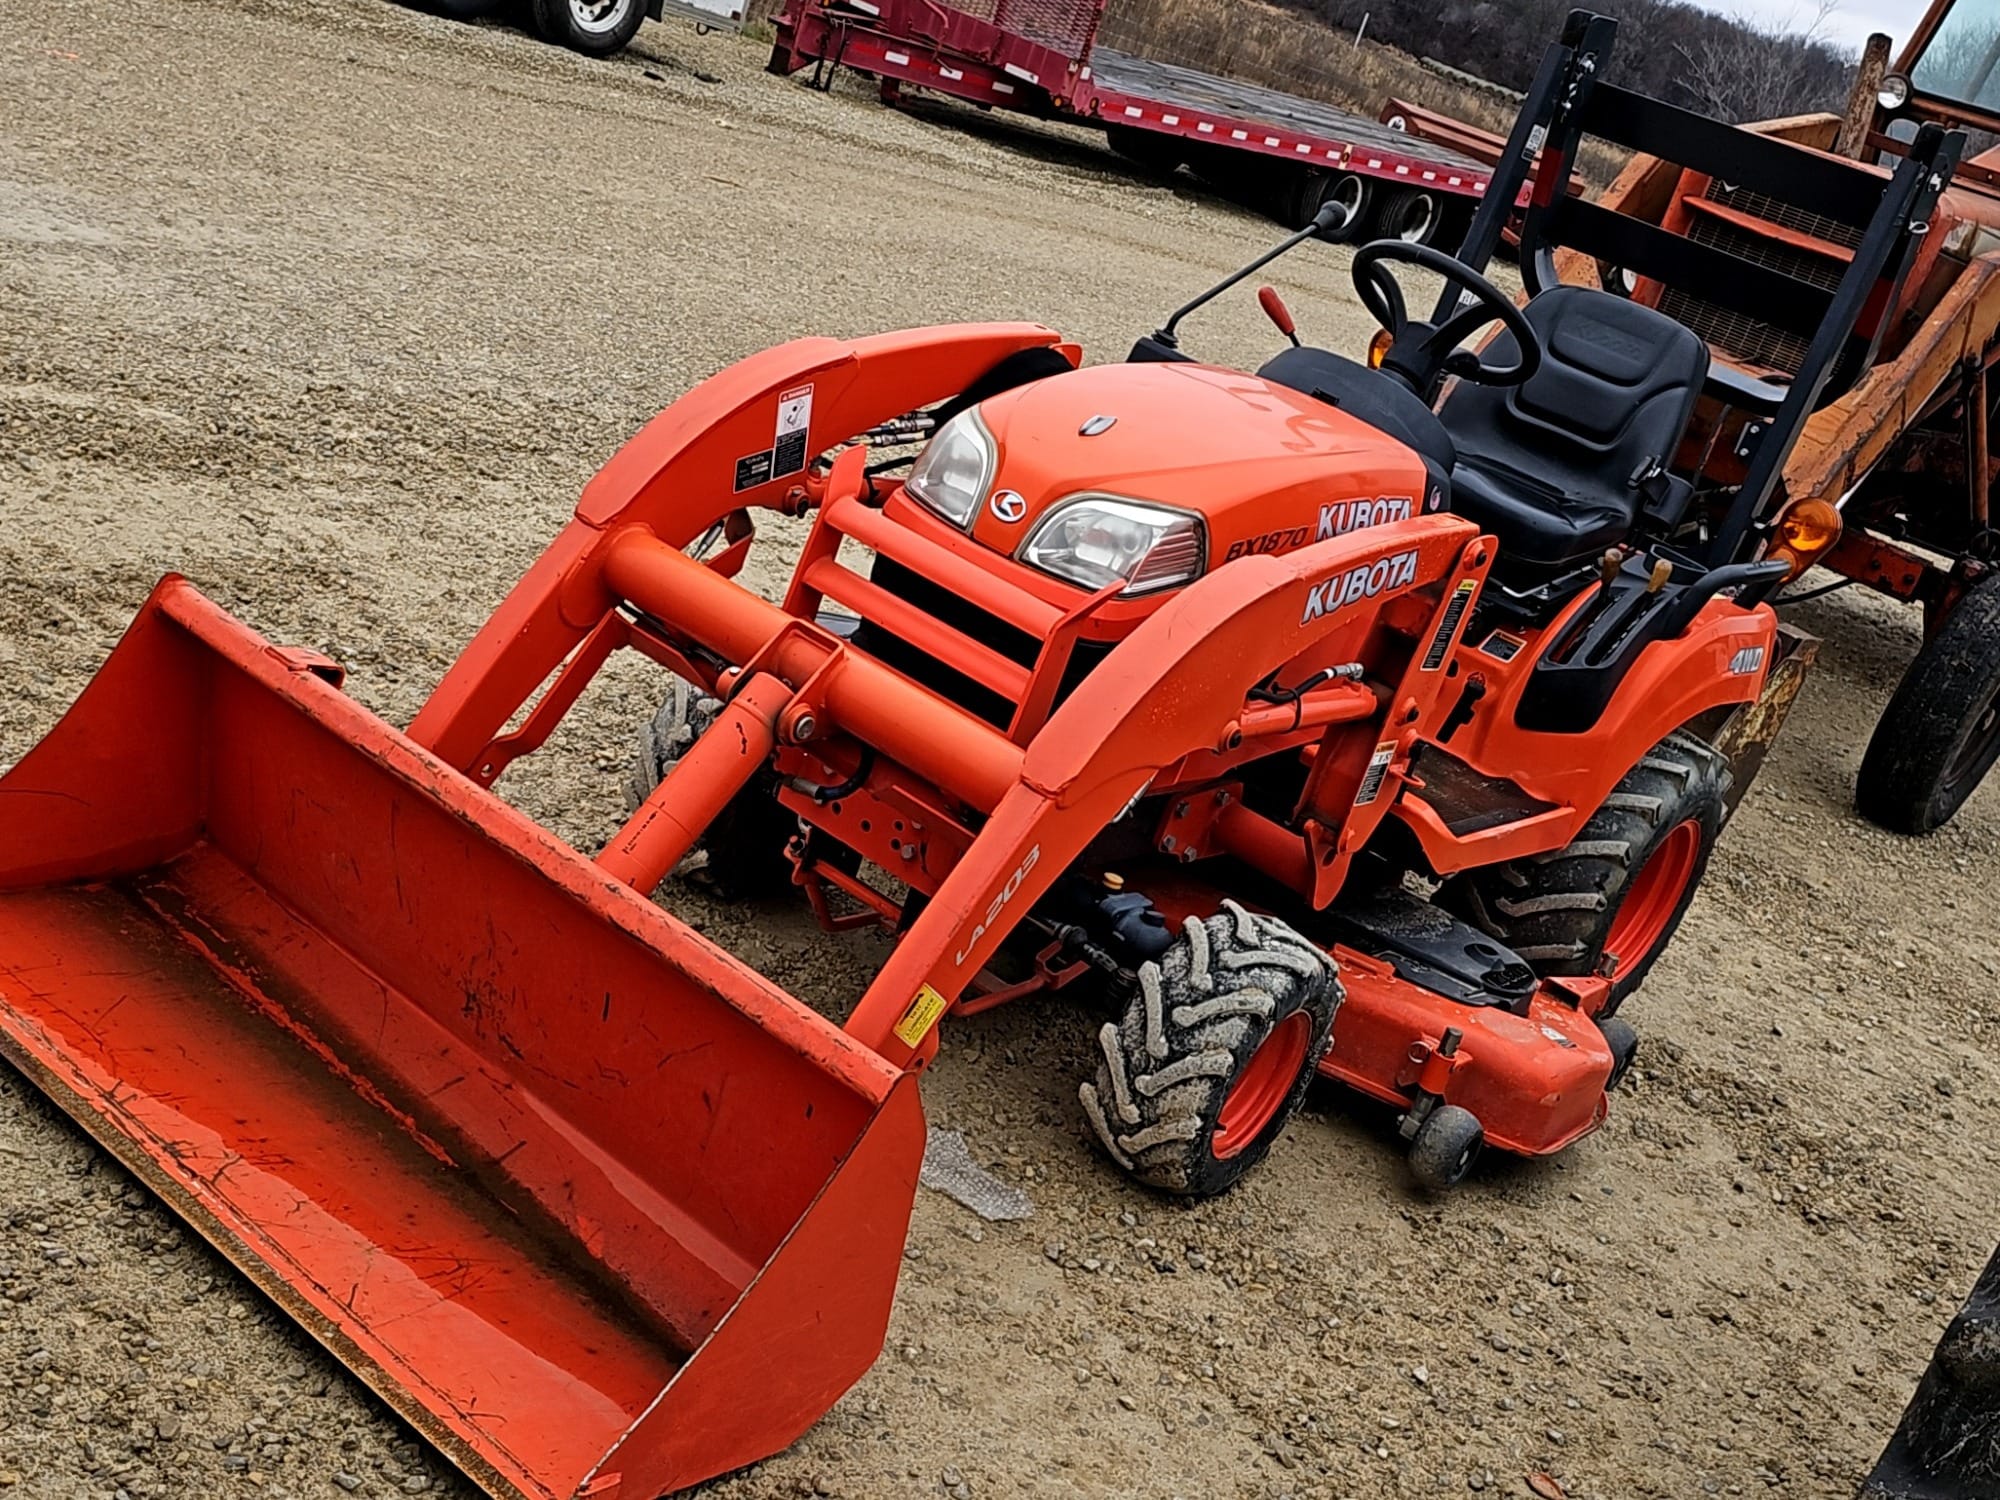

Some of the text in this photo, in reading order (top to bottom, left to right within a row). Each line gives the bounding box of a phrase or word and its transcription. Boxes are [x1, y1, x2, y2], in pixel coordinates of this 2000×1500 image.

[1314, 497, 1412, 542] KUBOTA
[1224, 527, 1310, 562] BX1870
[1300, 549, 1420, 625] KUBOTA
[1729, 646, 1764, 675] 4WD
[956, 843, 1040, 966] LA203
